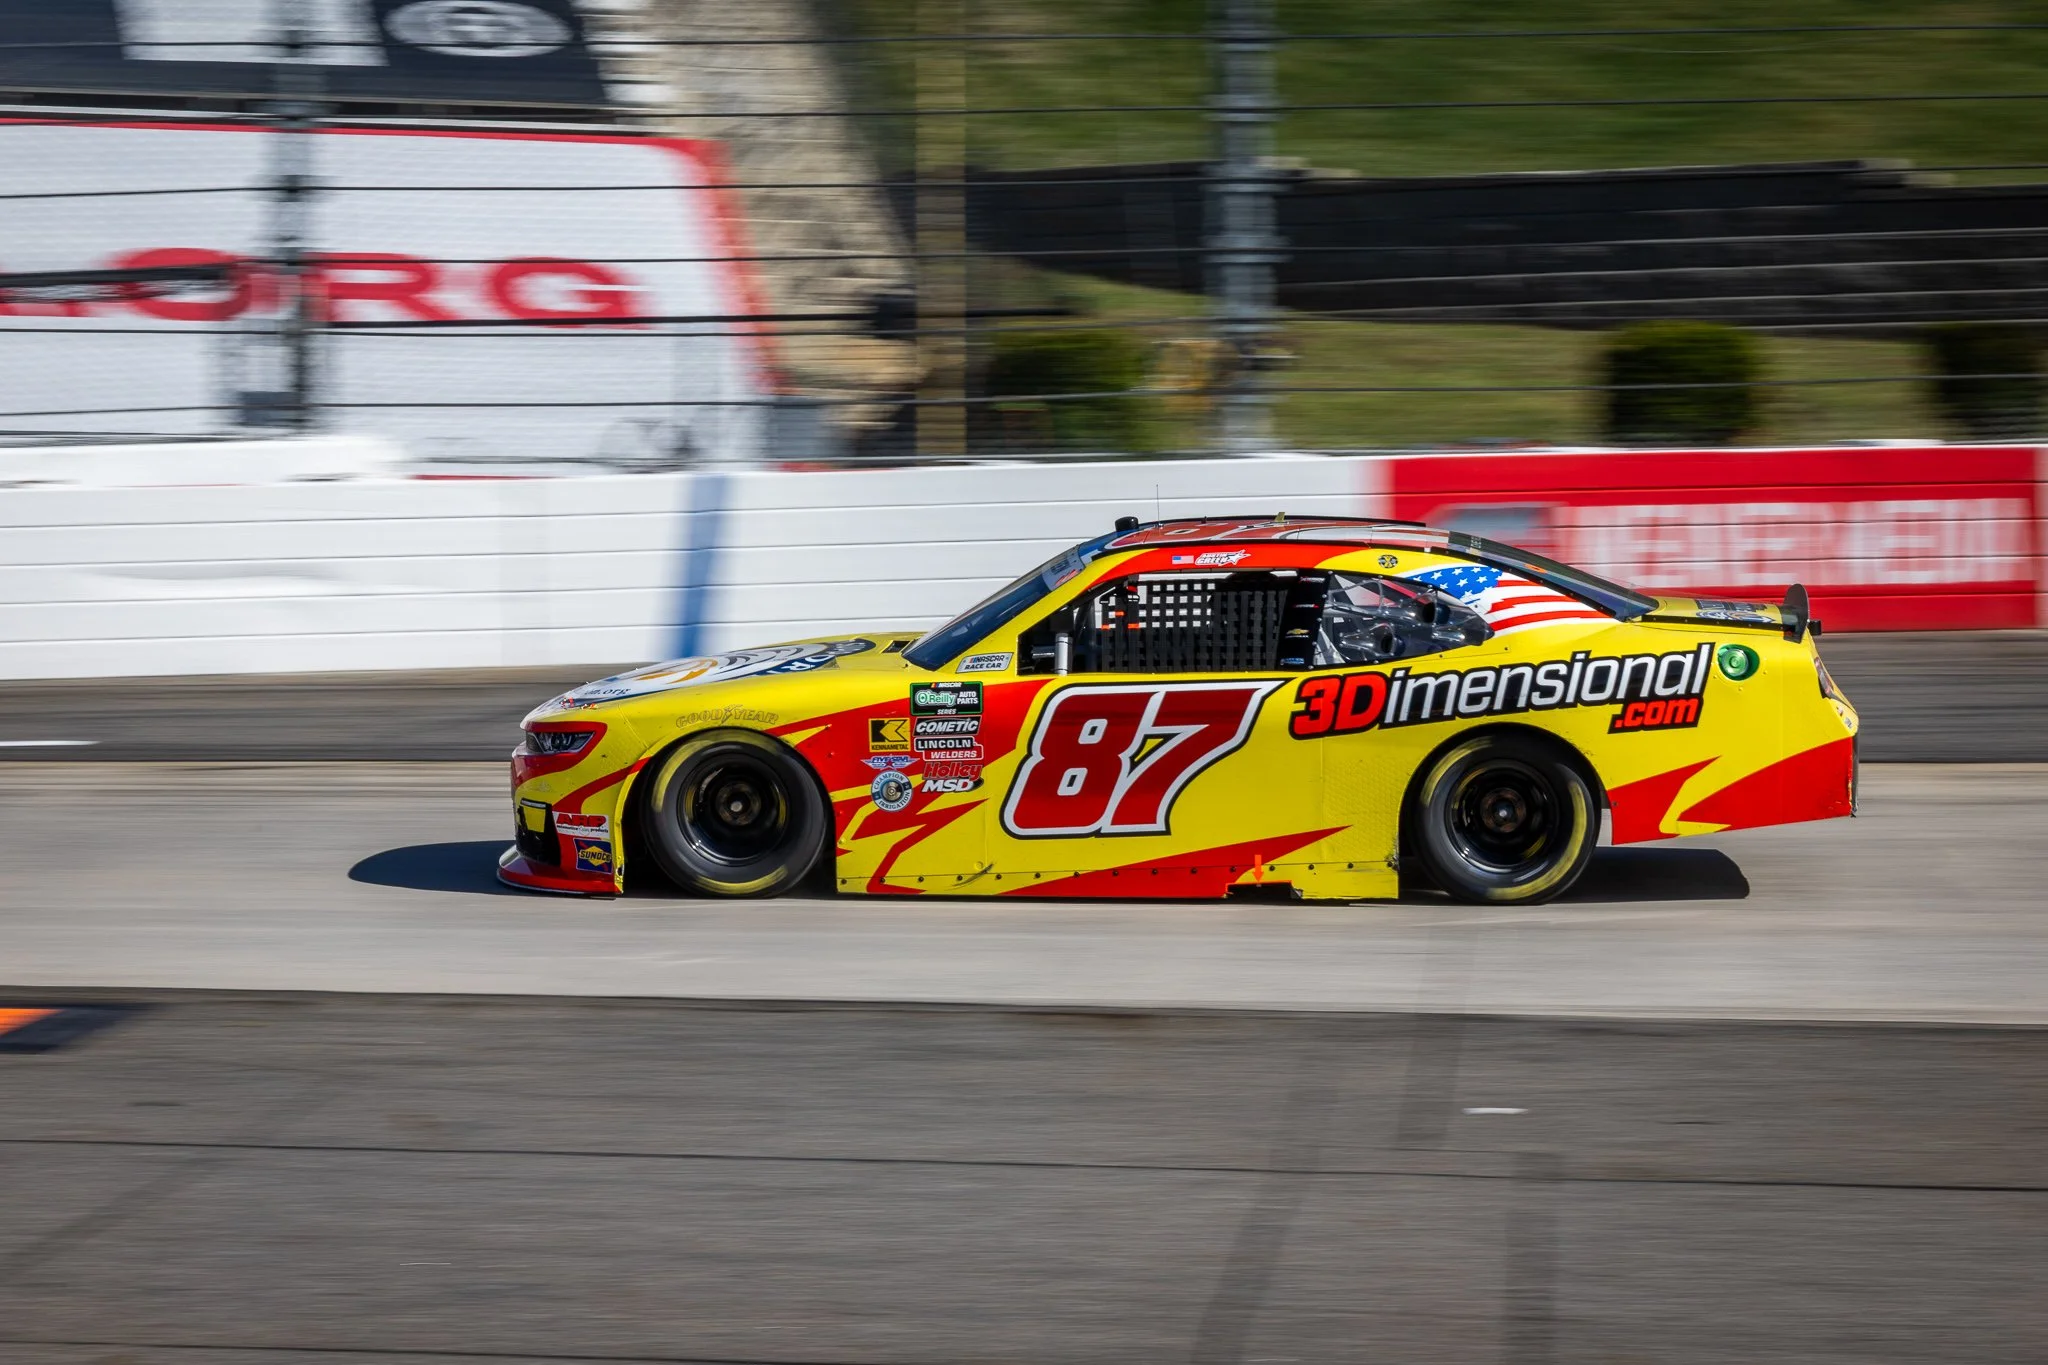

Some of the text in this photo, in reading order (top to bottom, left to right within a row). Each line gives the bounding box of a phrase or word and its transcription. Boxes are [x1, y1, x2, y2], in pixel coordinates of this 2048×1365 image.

[1293, 644, 1711, 735] 3Dimensional
[1614, 698, 1699, 729] .com
[916, 717, 979, 733] COMETIC
[917, 739, 972, 749] LINCOLN
[930, 750, 978, 759] WELDERS
[1001, 679, 1288, 838] 87
[923, 761, 983, 782] Holley
[873, 772, 905, 790] CHAMPION
[921, 778, 974, 793] MSD
[878, 791, 911, 810] IRRIGATION
[556, 813, 607, 828] ARP
[580, 850, 613, 861] SUNOCO
